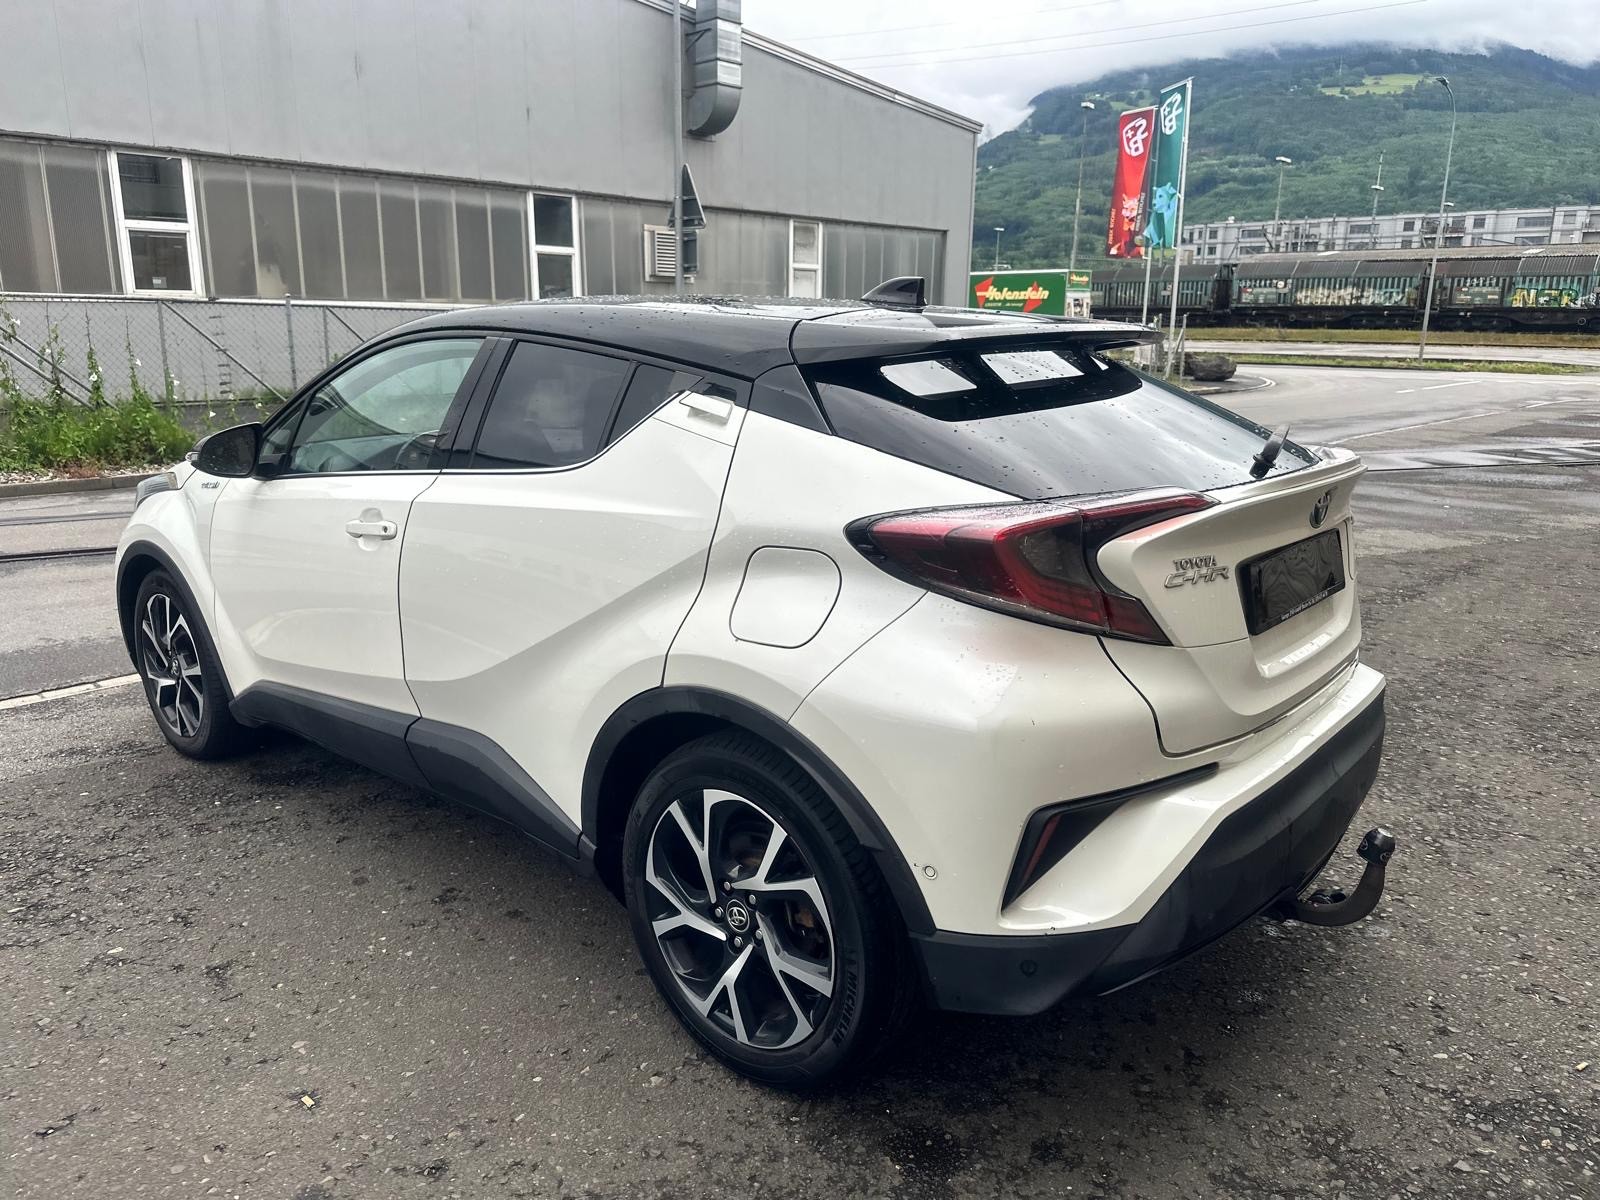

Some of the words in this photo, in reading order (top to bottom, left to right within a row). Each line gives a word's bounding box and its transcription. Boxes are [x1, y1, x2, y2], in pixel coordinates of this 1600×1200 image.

[977, 285, 1050, 300] Holenstein
[1173, 555, 1217, 572] TOYOTA
[1164, 566, 1230, 588] C-HR
[831, 969, 858, 1048] MICHELIN
